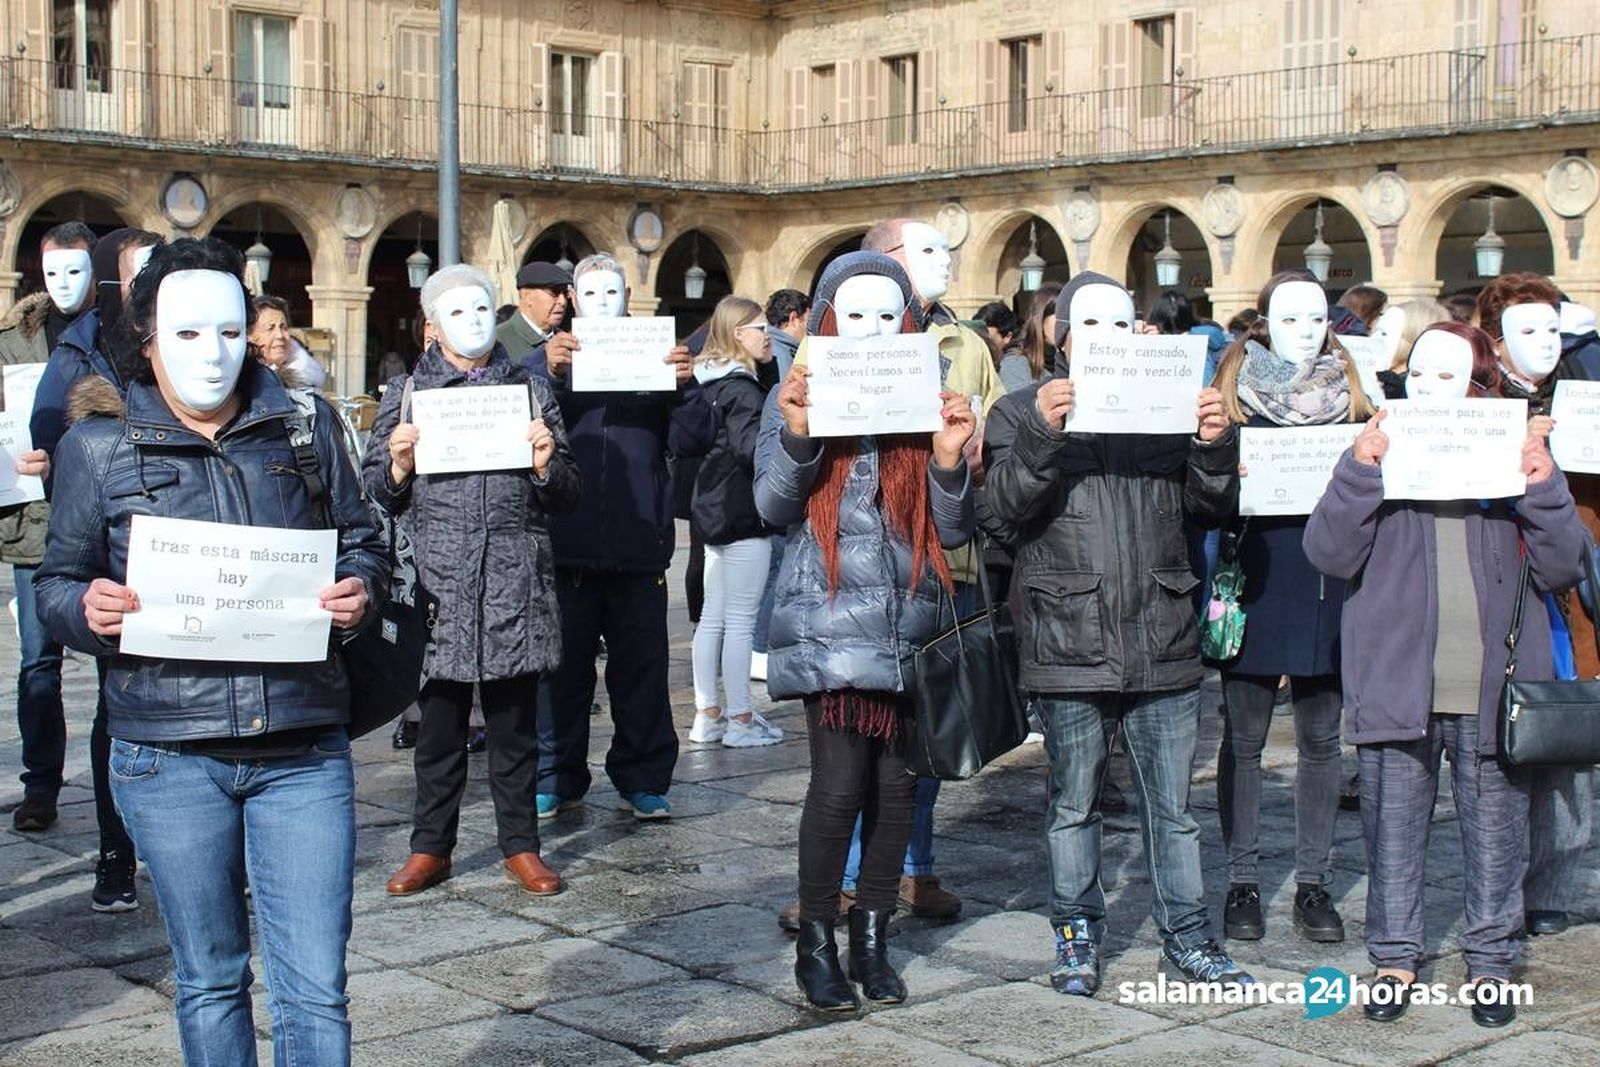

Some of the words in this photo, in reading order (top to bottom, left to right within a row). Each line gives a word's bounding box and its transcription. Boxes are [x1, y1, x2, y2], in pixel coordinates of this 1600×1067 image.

[826, 350, 861, 361] Somos
[1089, 342, 1128, 358] Estoy
[1135, 345, 1188, 360] cansado,
[830, 366, 904, 378] Necesitamos
[908, 366, 922, 375] un
[1083, 364, 1115, 376] pero
[1122, 367, 1137, 376] no
[1144, 366, 1193, 377] vencido
[859, 383, 894, 395] hogar
[1463, 425, 1478, 436] no
[1484, 426, 1507, 436] una
[149, 536, 191, 555] tras
[200, 544, 241, 560] esta
[250, 546, 320, 564] máscara
[217, 567, 249, 588] hay
[175, 591, 206, 606] una
[215, 596, 286, 611] persona
